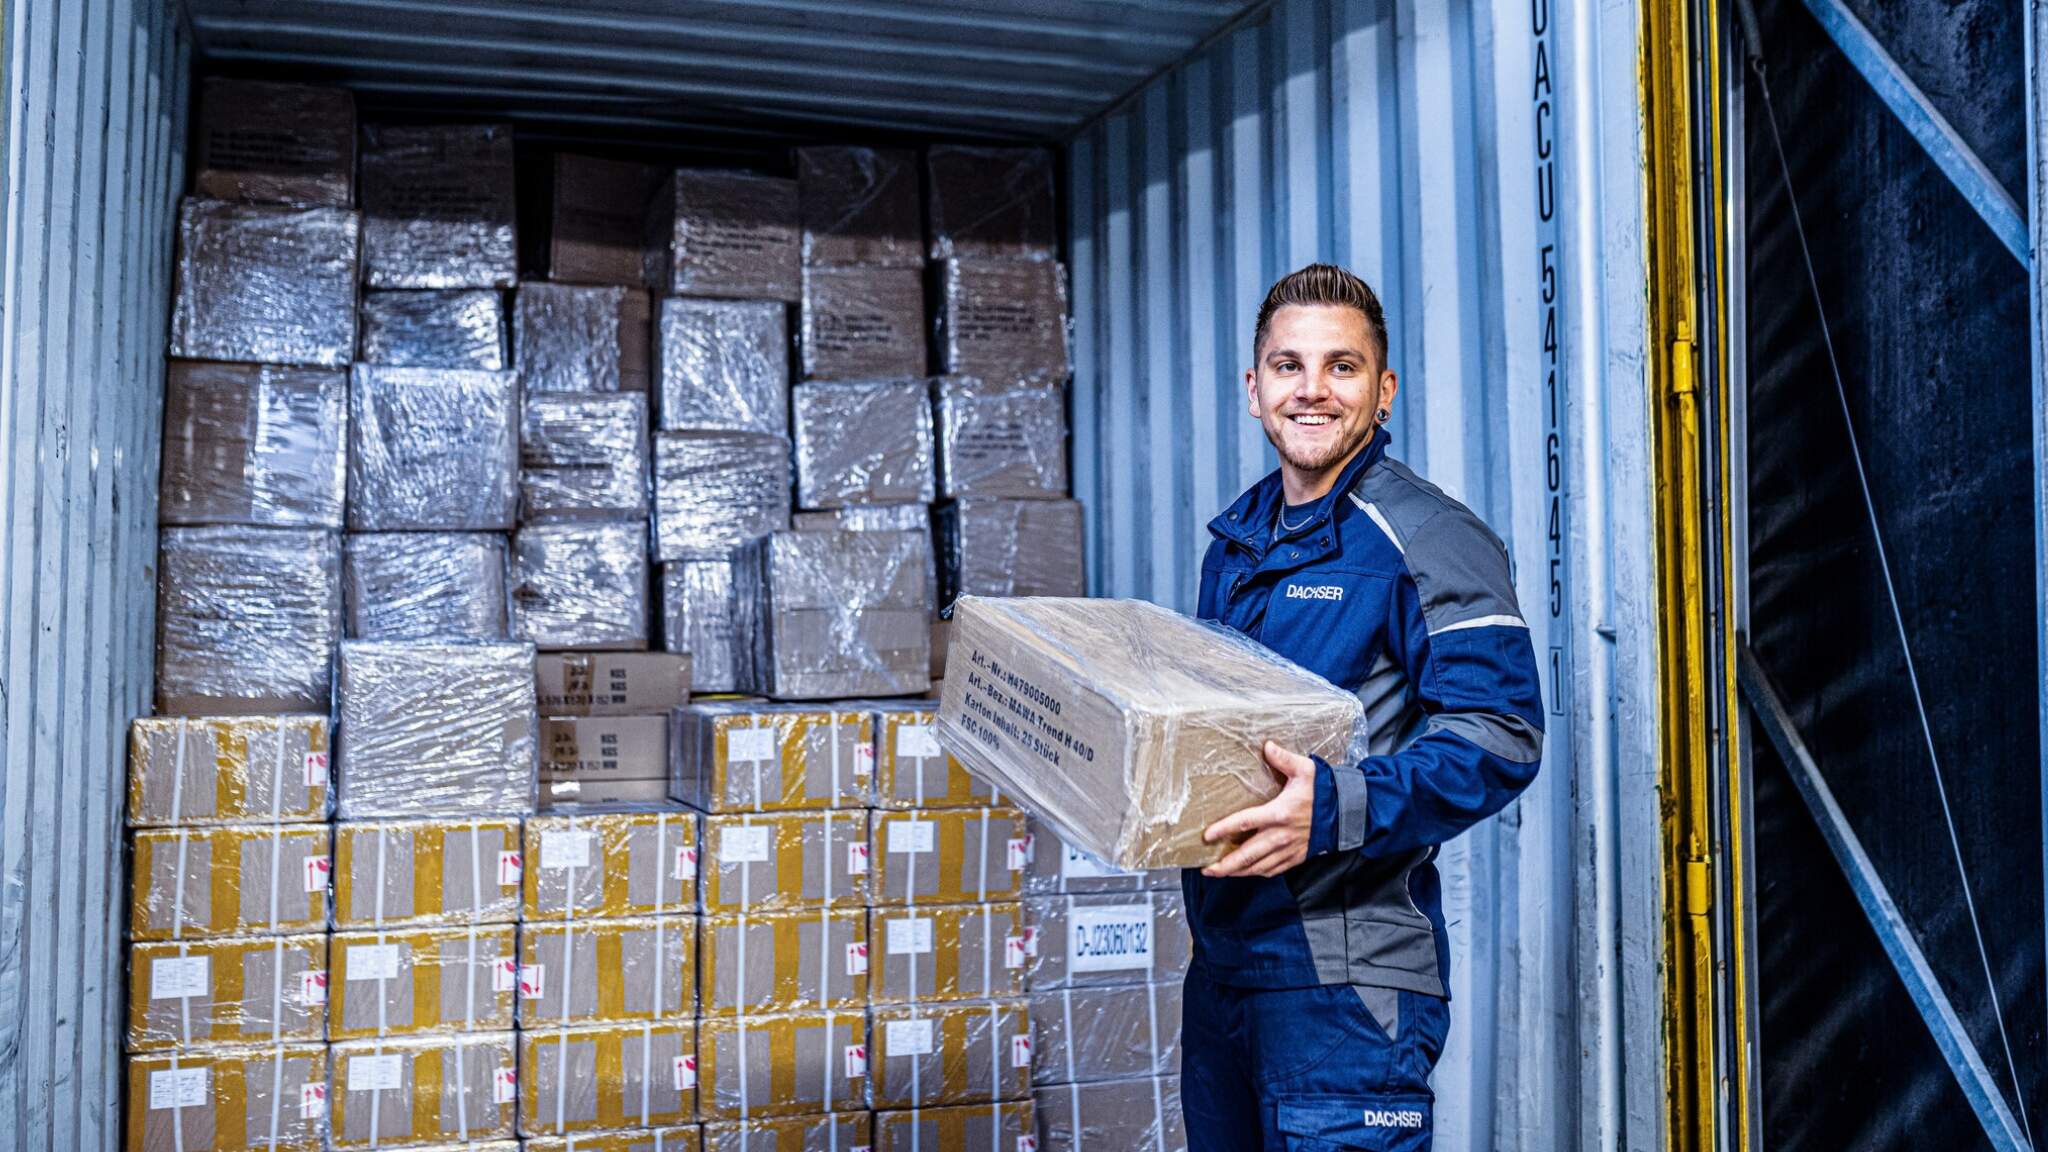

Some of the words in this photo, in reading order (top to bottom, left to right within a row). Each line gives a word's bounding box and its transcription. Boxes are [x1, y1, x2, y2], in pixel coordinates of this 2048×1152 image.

[1541, 245, 1561, 618] 541645
[1286, 584, 1343, 600] DACHSER
[961, 713, 977, 734] FSC
[979, 726, 1000, 750] 100%
[965, 692, 992, 720] Karton
[993, 711, 1020, 740] Inhalt:
[1021, 730, 1033, 747] 25
[1033, 738, 1060, 766] Stück
[1008, 697, 1035, 726] MAWA
[1038, 715, 1064, 742] Trend
[1064, 733, 1072, 748] H
[1073, 740, 1094, 762] 40/D
[1364, 1109, 1422, 1128] DACHSER
